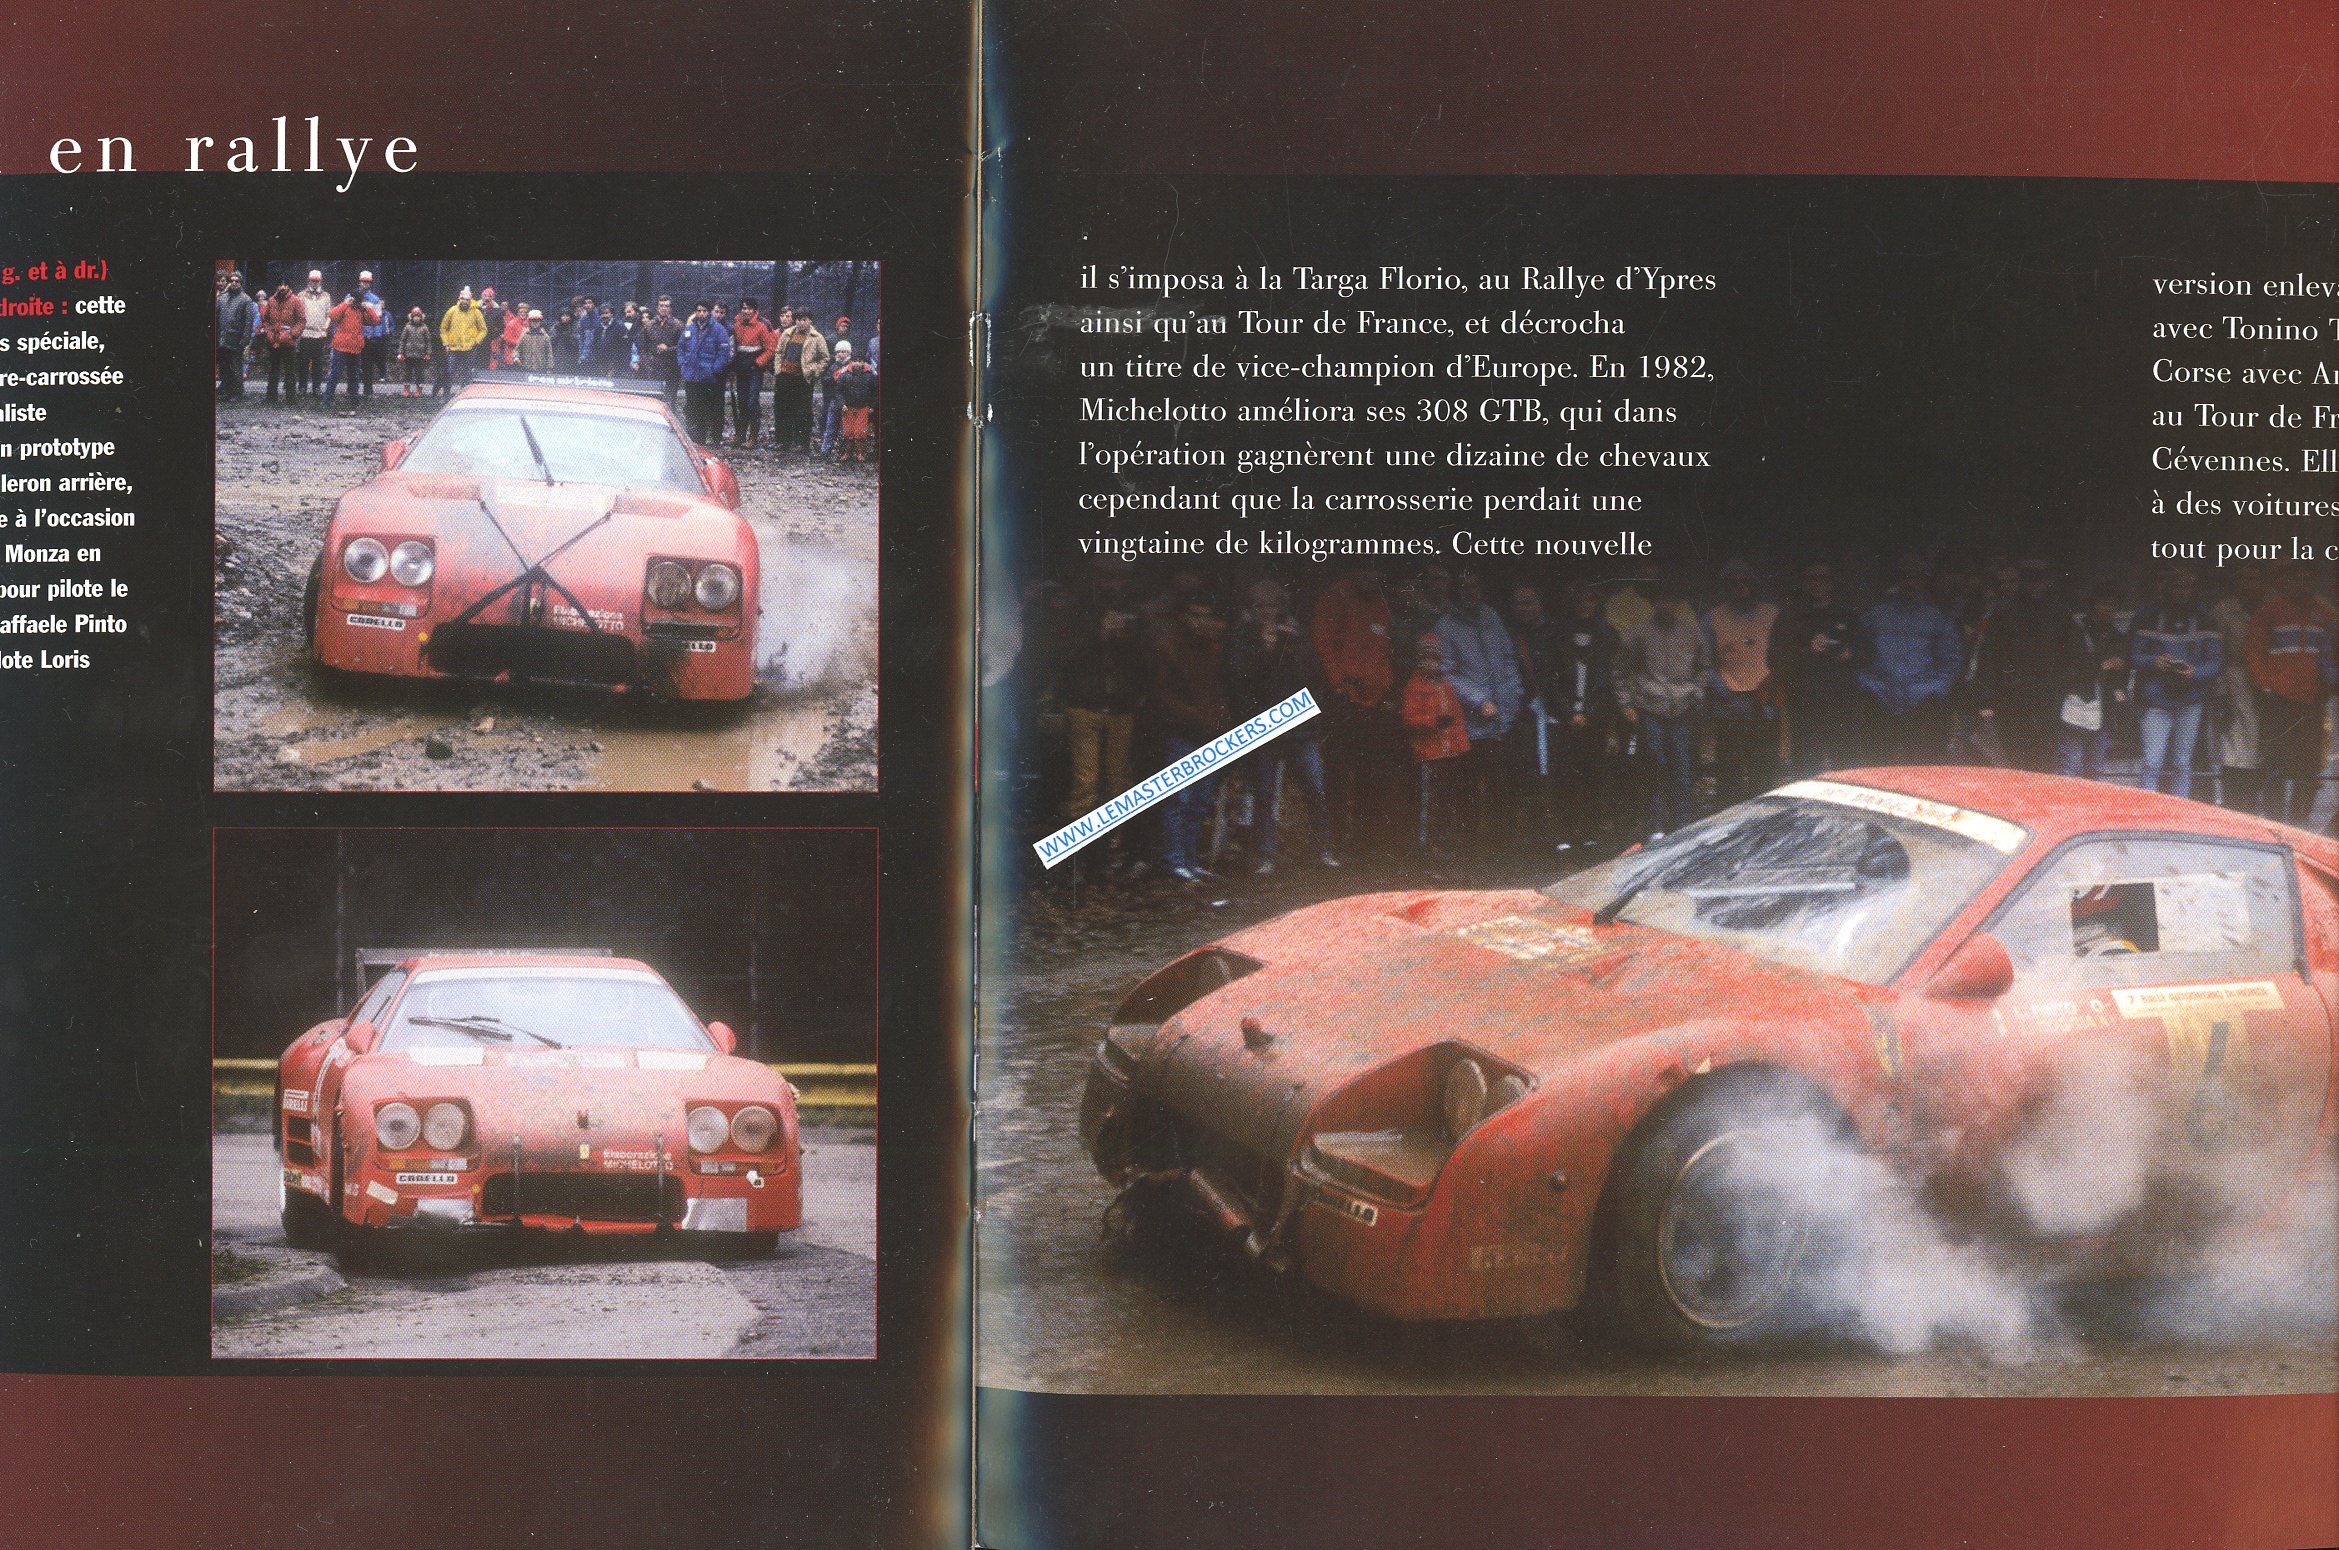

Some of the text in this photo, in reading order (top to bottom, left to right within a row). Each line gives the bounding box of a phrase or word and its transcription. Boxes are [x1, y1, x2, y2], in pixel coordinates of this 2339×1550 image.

[49, 115, 418, 193] en rallye
[1, 259, 107, 285] g. et à dr.)
[1080, 264, 1716, 299] il s’imposa à la Targa Florio, au Rallye d’Ypres
[2152, 271, 2253, 296] version
[0, 295, 126, 317] droite : cette
[1080, 309, 1626, 342] ainsi qu’au Tour de France, et décrocha
[2152, 322, 2213, 339] avec
[2222, 315, 2318, 341] Tonino
[0, 330, 105, 355] s spéciale,
[0, 365, 124, 387] re-carrossée
[1081, 353, 1715, 387] un titre de vice-champion d’Europe. En 1982,
[2152, 358, 2232, 384] Corse
[2242, 368, 2302, 385] avec
[1079, 396, 1677, 431] Michelotto améliora ses 308 GTB, qui dans
[2152, 410, 2182, 427] au
[2194, 403, 2260, 428] Tour
[2269, 404, 2302, 429] de
[0, 437, 116, 461] n prototype
[1079, 440, 1711, 474] l’opération gagnèrent une dizaine de chevaux
[2152, 445, 2338, 473] Cévennes. Ell
[1, 471, 133, 495] leron arrière,
[1078, 485, 1642, 519] cependant que la carrosserie perdait une
[2151, 489, 2339, 517] à des voitures
[0, 507, 135, 529] e à l’occasion
[5, 543, 101, 563] Monza en
[1077, 529, 1652, 563] vingtaine de kilogrammes. Cette nouvelle
[2151, 540, 2207, 559] tout
[2217, 543, 2282, 568] pour
[2291, 536, 2315, 560] la
[47, 578, 104, 602] pilote
[110, 578, 129, 598] le
[0, 613, 128, 634] affaele Pinto
[40, 649, 91, 669] Loris
[602, 1159, 674, 1171] MICHELOTO
